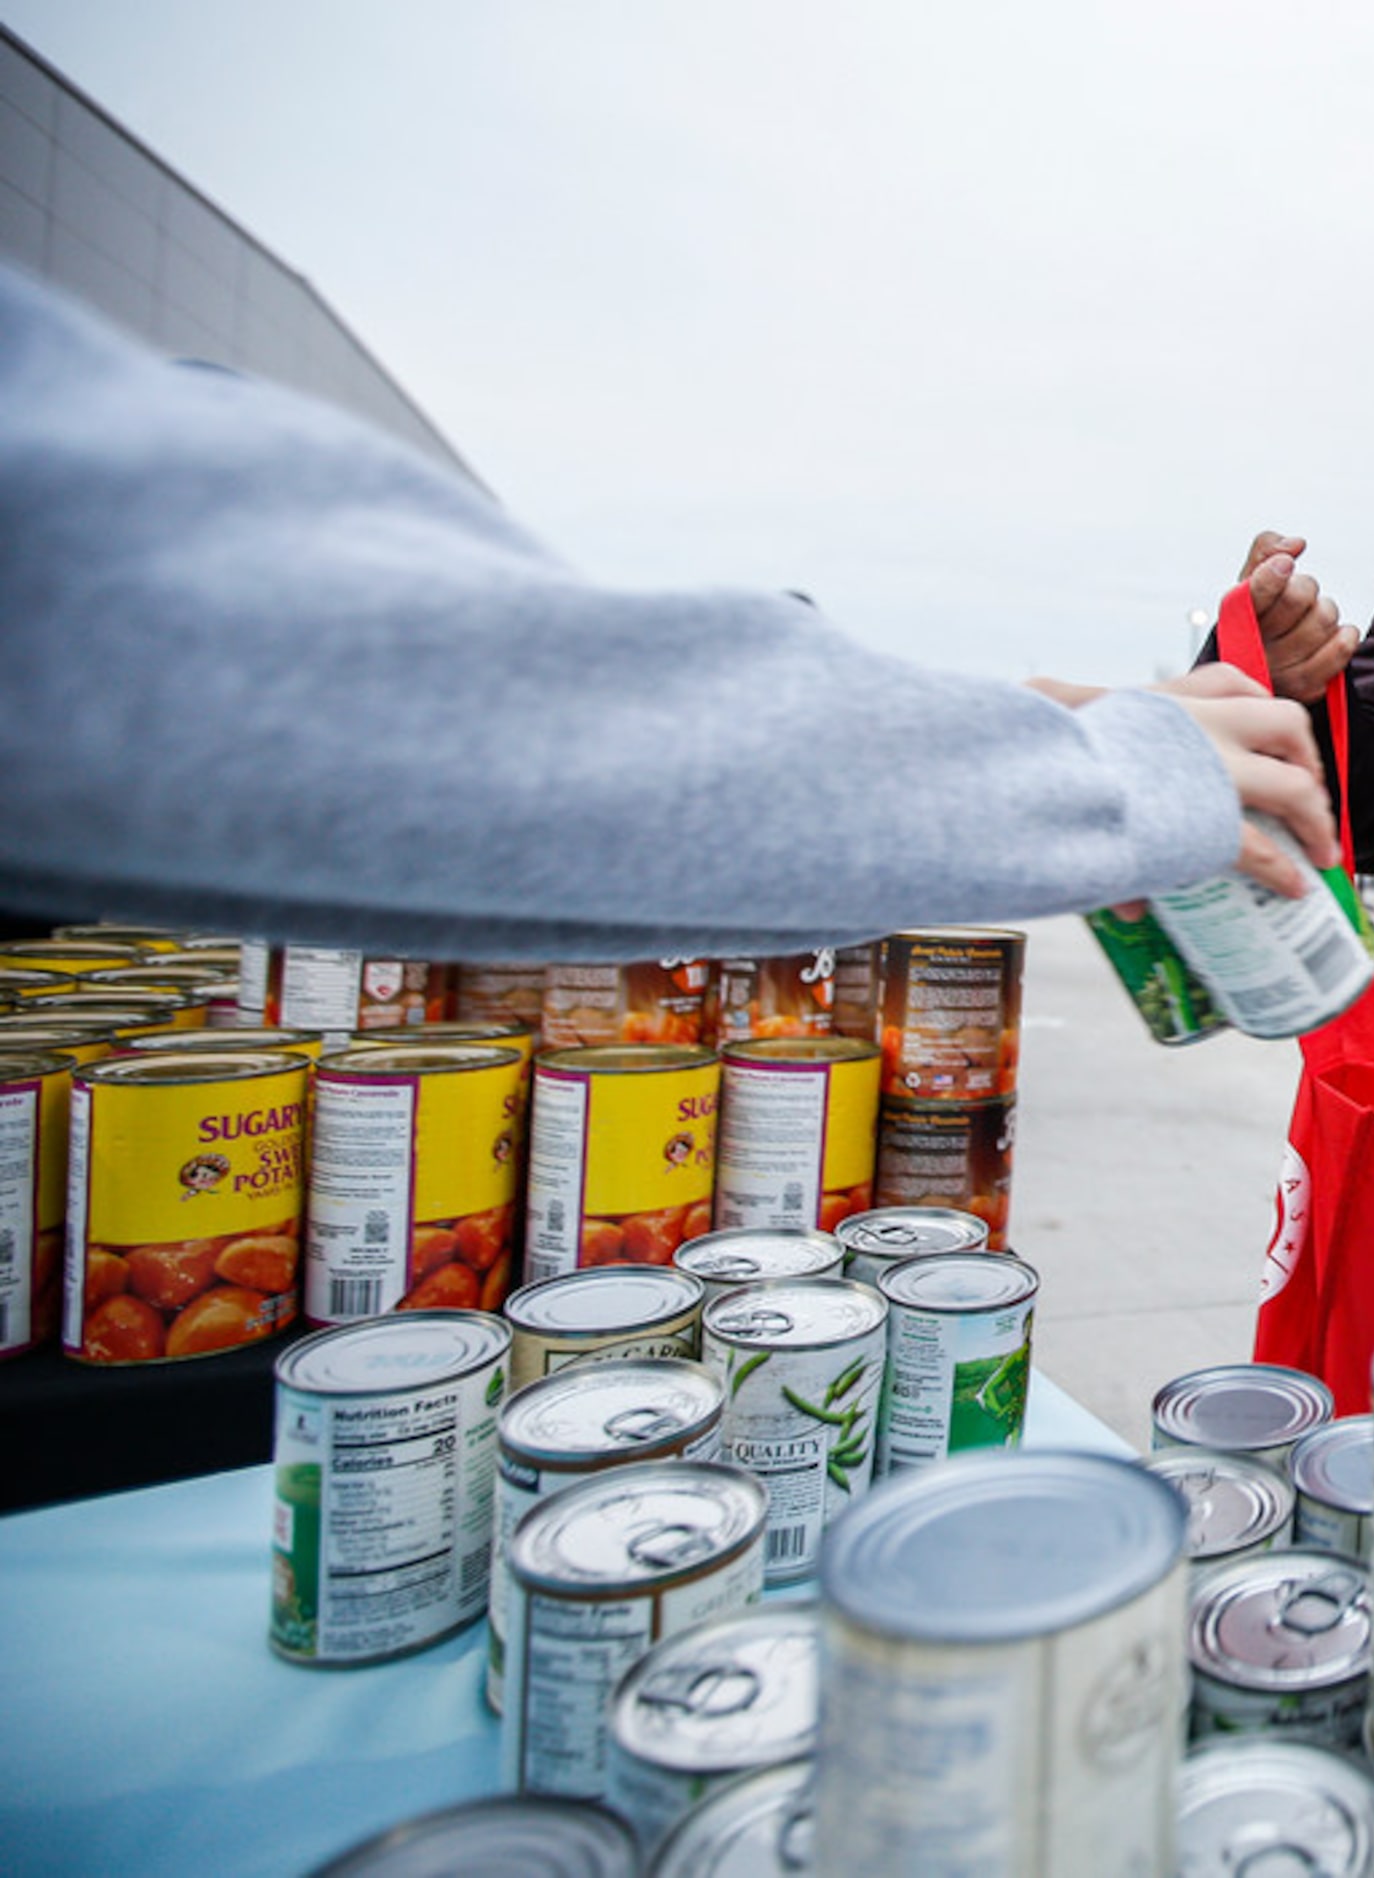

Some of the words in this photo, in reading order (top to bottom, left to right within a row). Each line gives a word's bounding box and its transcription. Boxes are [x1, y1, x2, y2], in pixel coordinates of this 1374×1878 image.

[333, 1404, 411, 1422] Nutrition
[414, 1394, 458, 1414] Facts
[433, 1433, 457, 1455] 20
[736, 1439, 820, 1464] QUALITY
[332, 1455, 394, 1470] Calories
